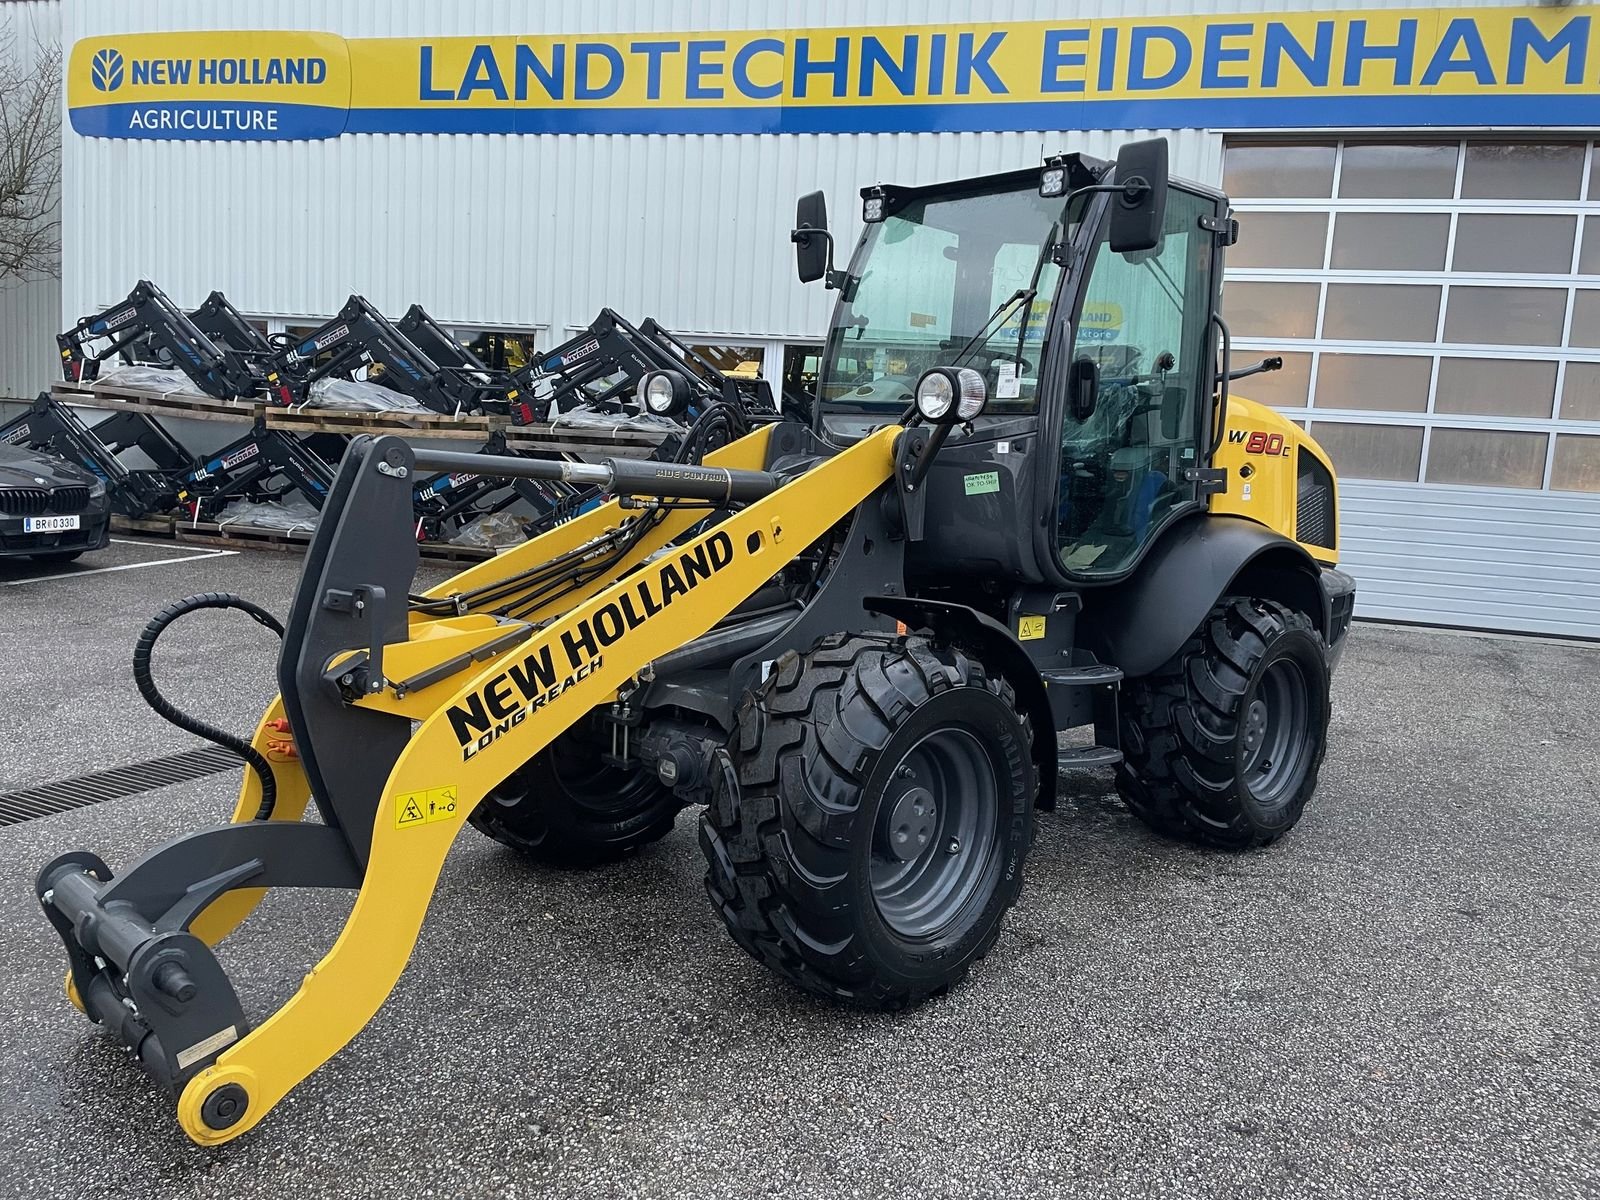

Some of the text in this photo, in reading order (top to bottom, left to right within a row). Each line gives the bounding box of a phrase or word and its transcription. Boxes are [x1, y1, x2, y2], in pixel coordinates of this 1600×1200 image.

[419, 16, 1600, 101] LANDTECHNIK EIDENHAM
[131, 57, 327, 85] NEW HOLLAND
[128, 108, 279, 132] AGRICULTURE
[111, 310, 136, 327] HYDRAC
[320, 328, 349, 347] HYDRAC
[567, 343, 599, 363] HYDRAC
[228, 448, 258, 467] HYDRAC
[288, 456, 305, 472] EURO
[655, 469, 728, 483] RIDE CONTROL
[445, 529, 735, 748] NEW HOLLAND
[462, 654, 605, 763] LONG REACH
[997, 732, 1026, 842] ALLIANCE
